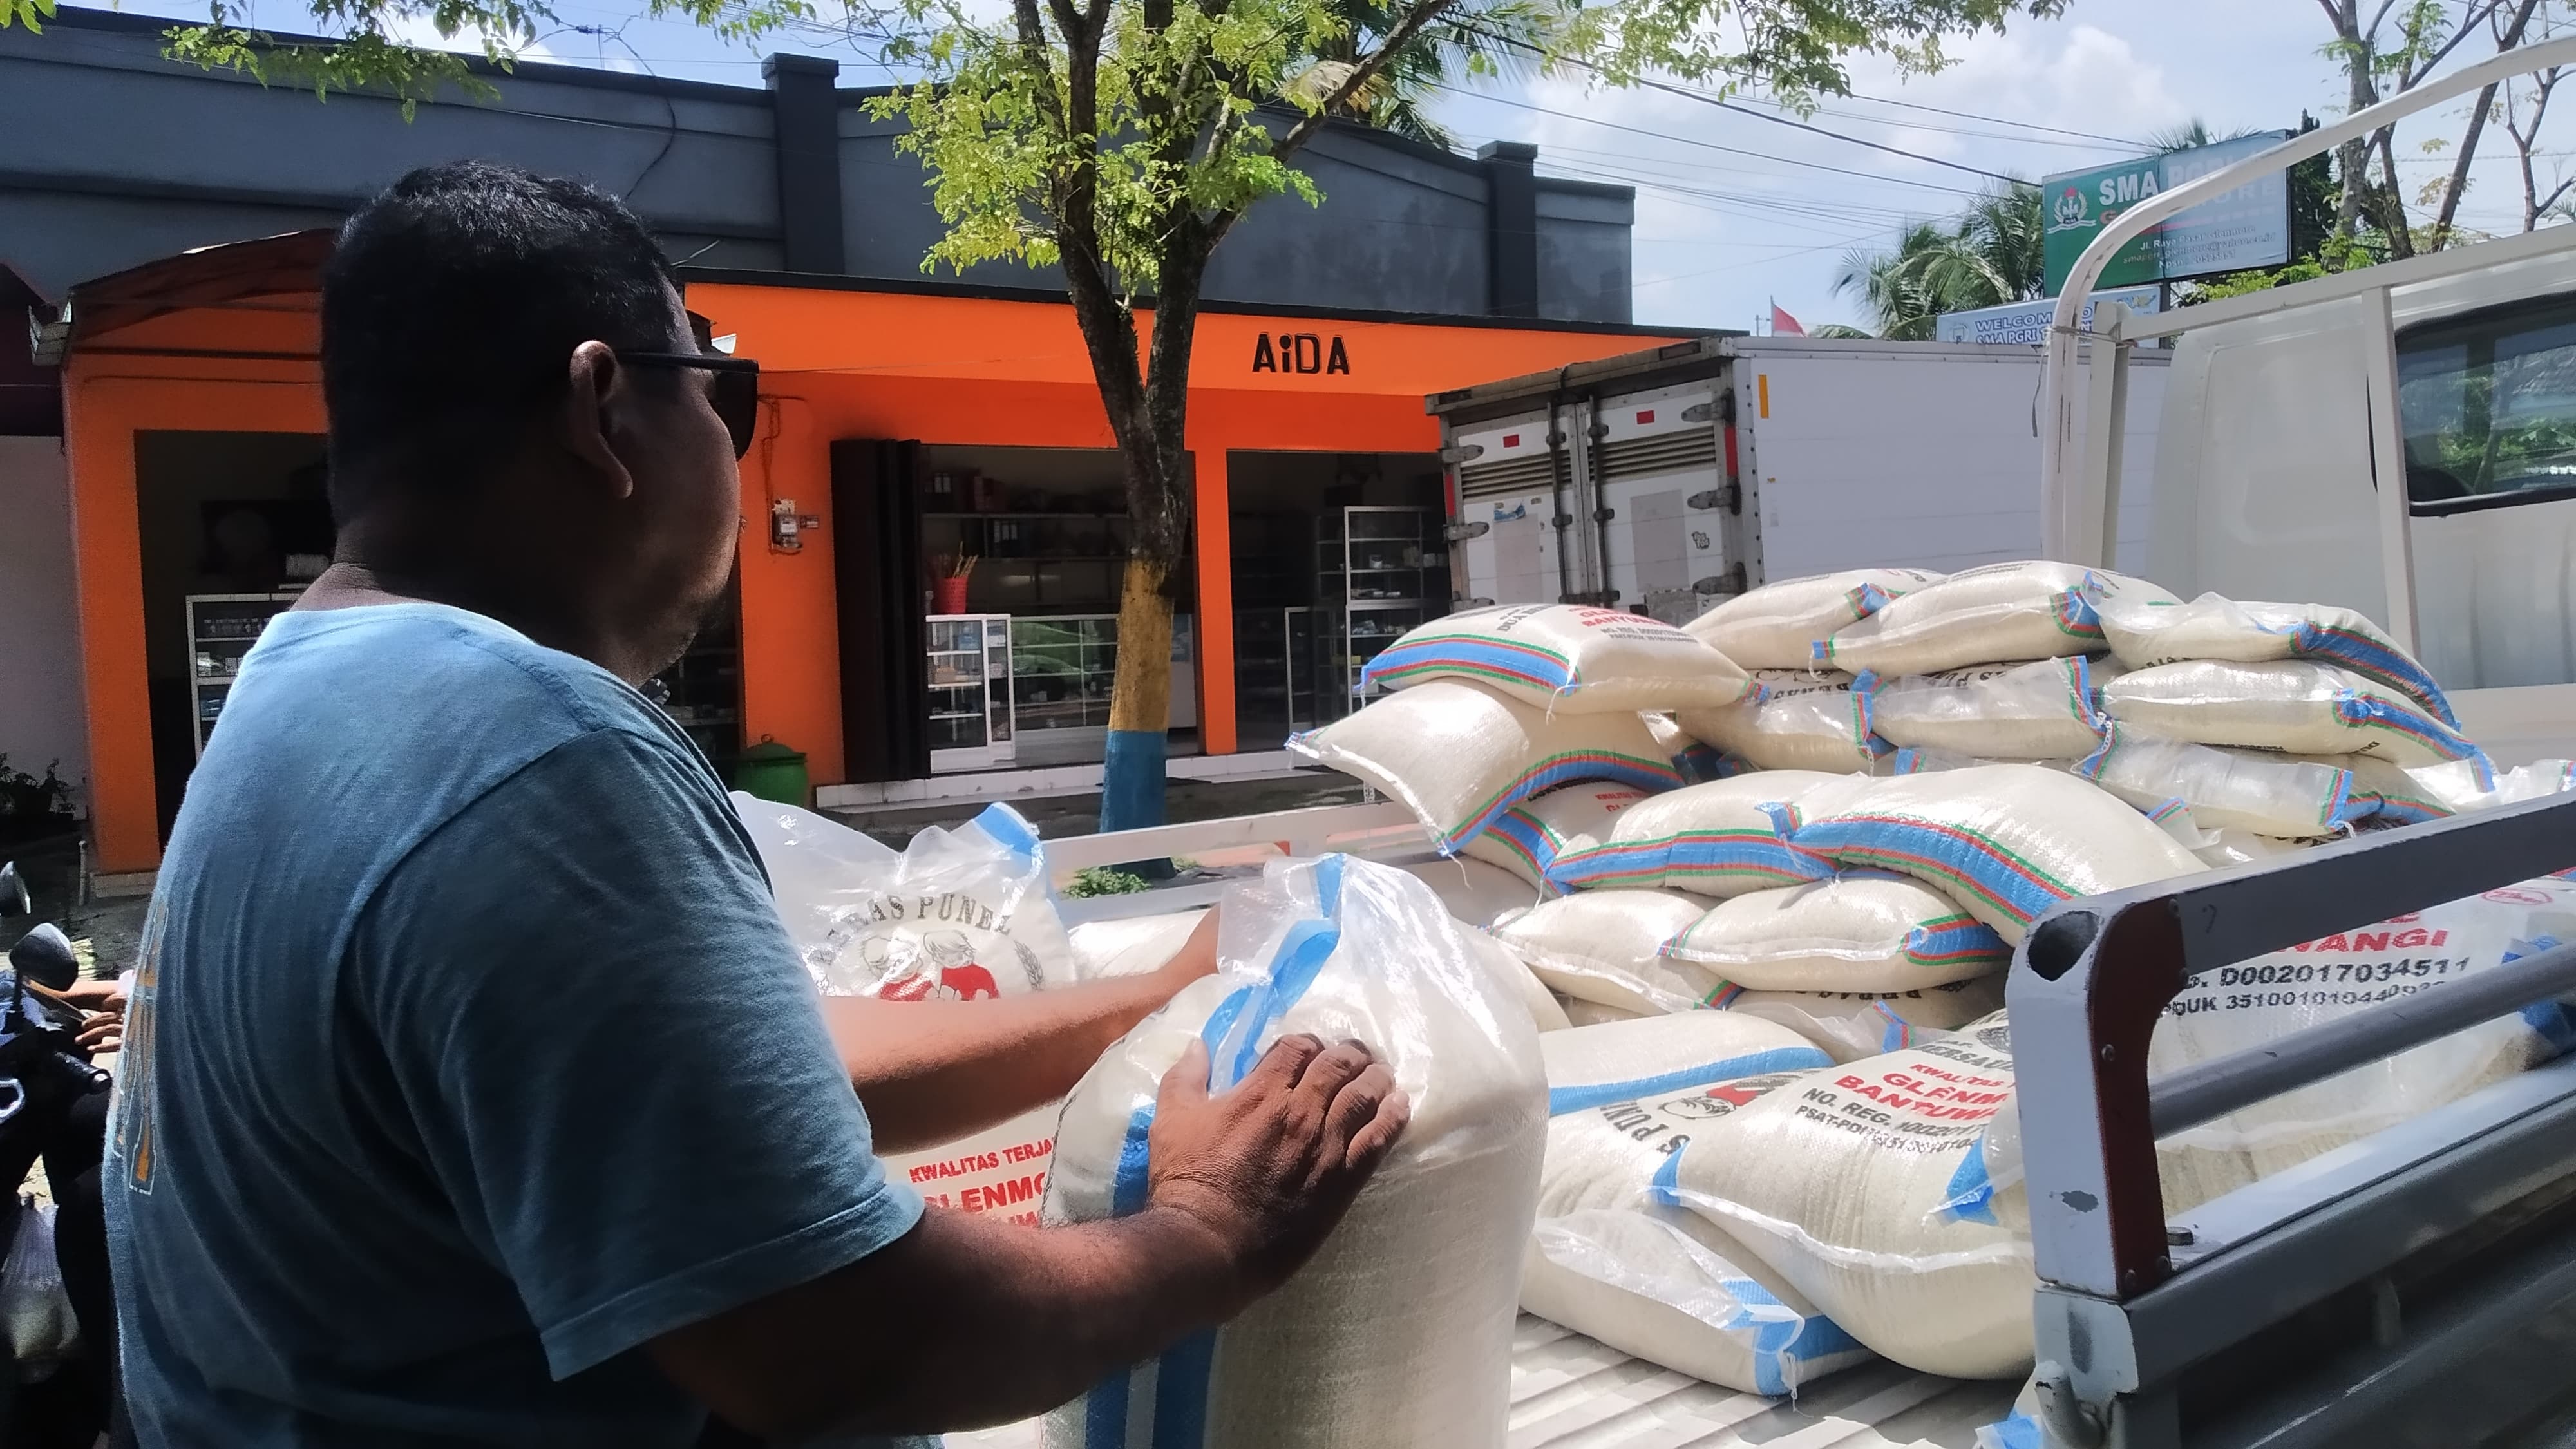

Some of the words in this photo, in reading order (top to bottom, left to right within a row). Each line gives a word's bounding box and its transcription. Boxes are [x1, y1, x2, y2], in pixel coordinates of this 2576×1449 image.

[2099, 171, 2158, 206] SMA
[1975, 312, 2054, 332] WELCOM
[2007, 328, 2038, 345] PGRI
[1882, 1073, 2010, 1104] GLENM
[1801, 1087, 1835, 1107] NO.
[1840, 1102, 1891, 1126] REG.
[909, 1151, 999, 1184] KWALITAS
[1002, 1138, 1054, 1164] TERJA
